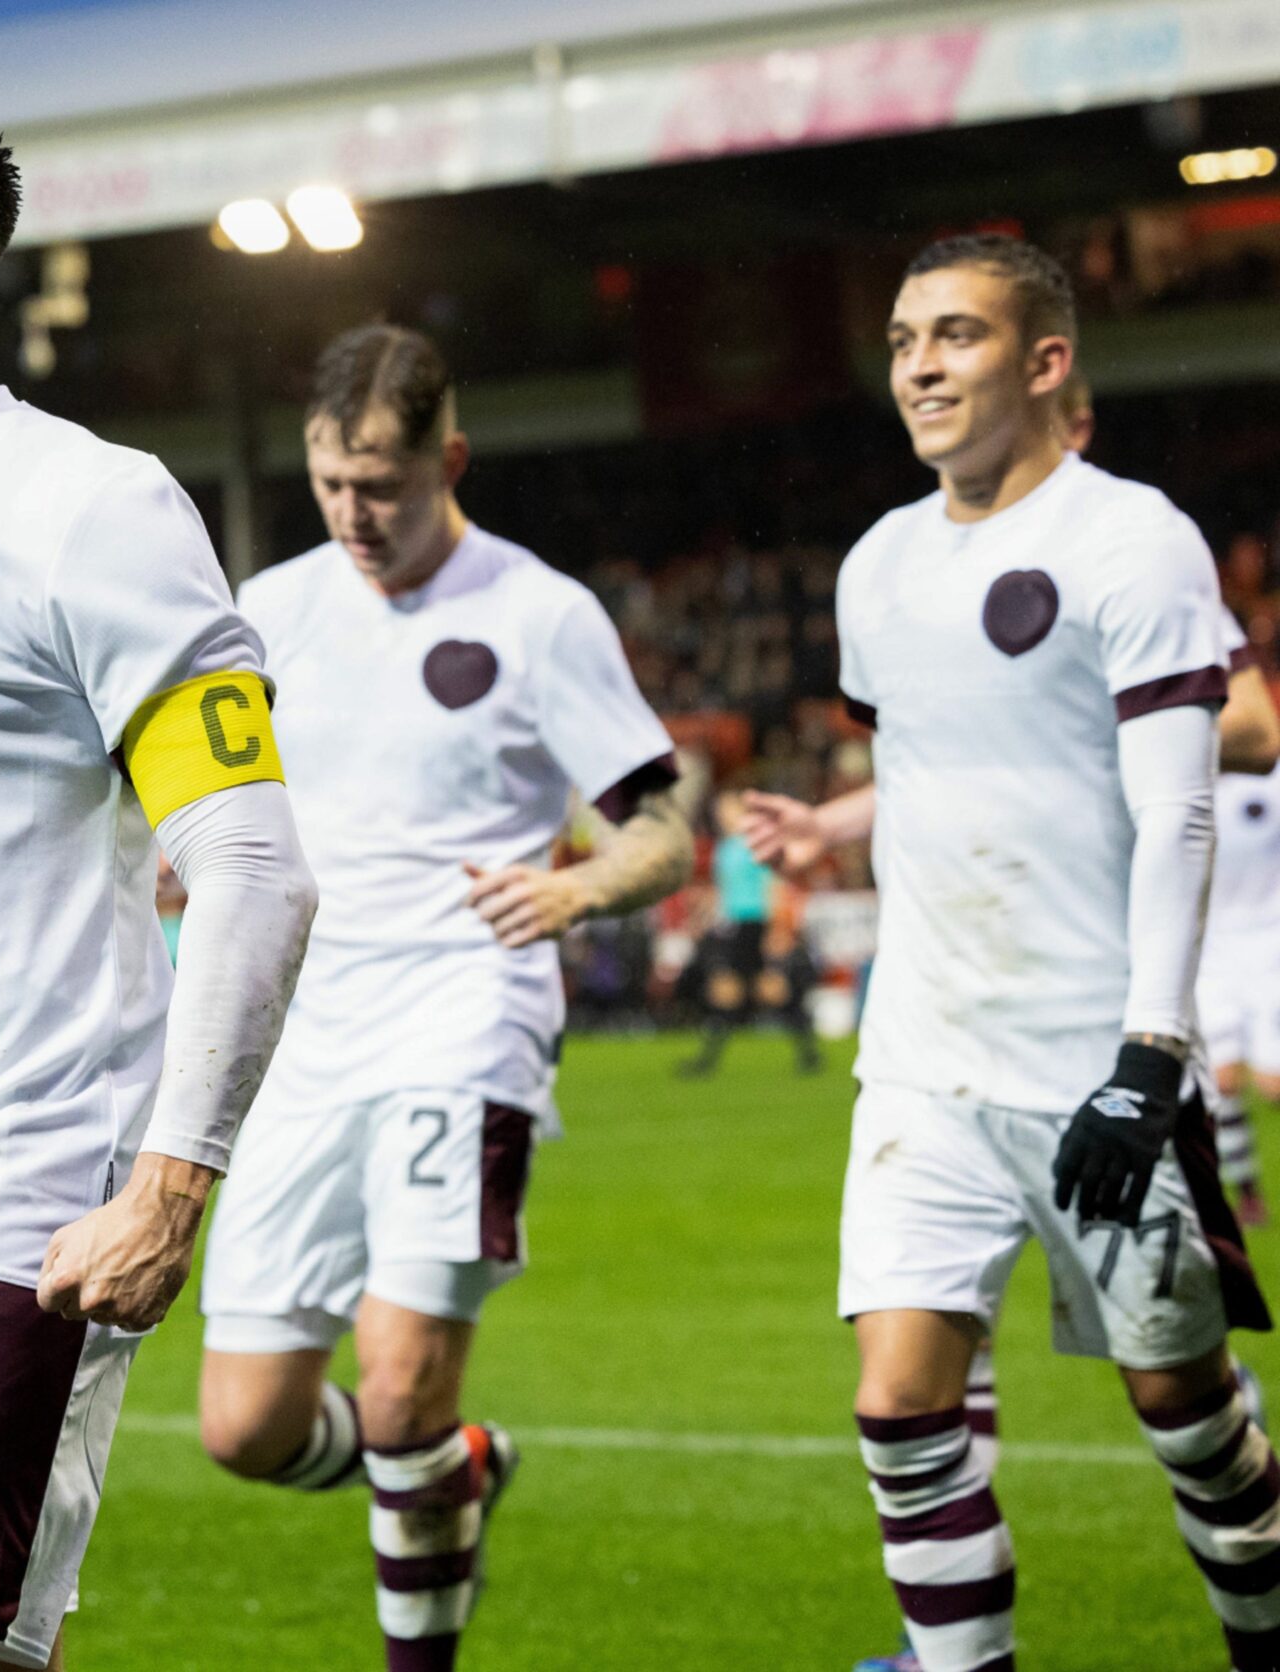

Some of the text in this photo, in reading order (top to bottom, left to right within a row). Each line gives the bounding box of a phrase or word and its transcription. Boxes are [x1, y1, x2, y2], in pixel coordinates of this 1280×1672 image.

[200, 684, 260, 768] C
[408, 1107, 448, 1187] 2
[1078, 1208, 1180, 1299] 77
